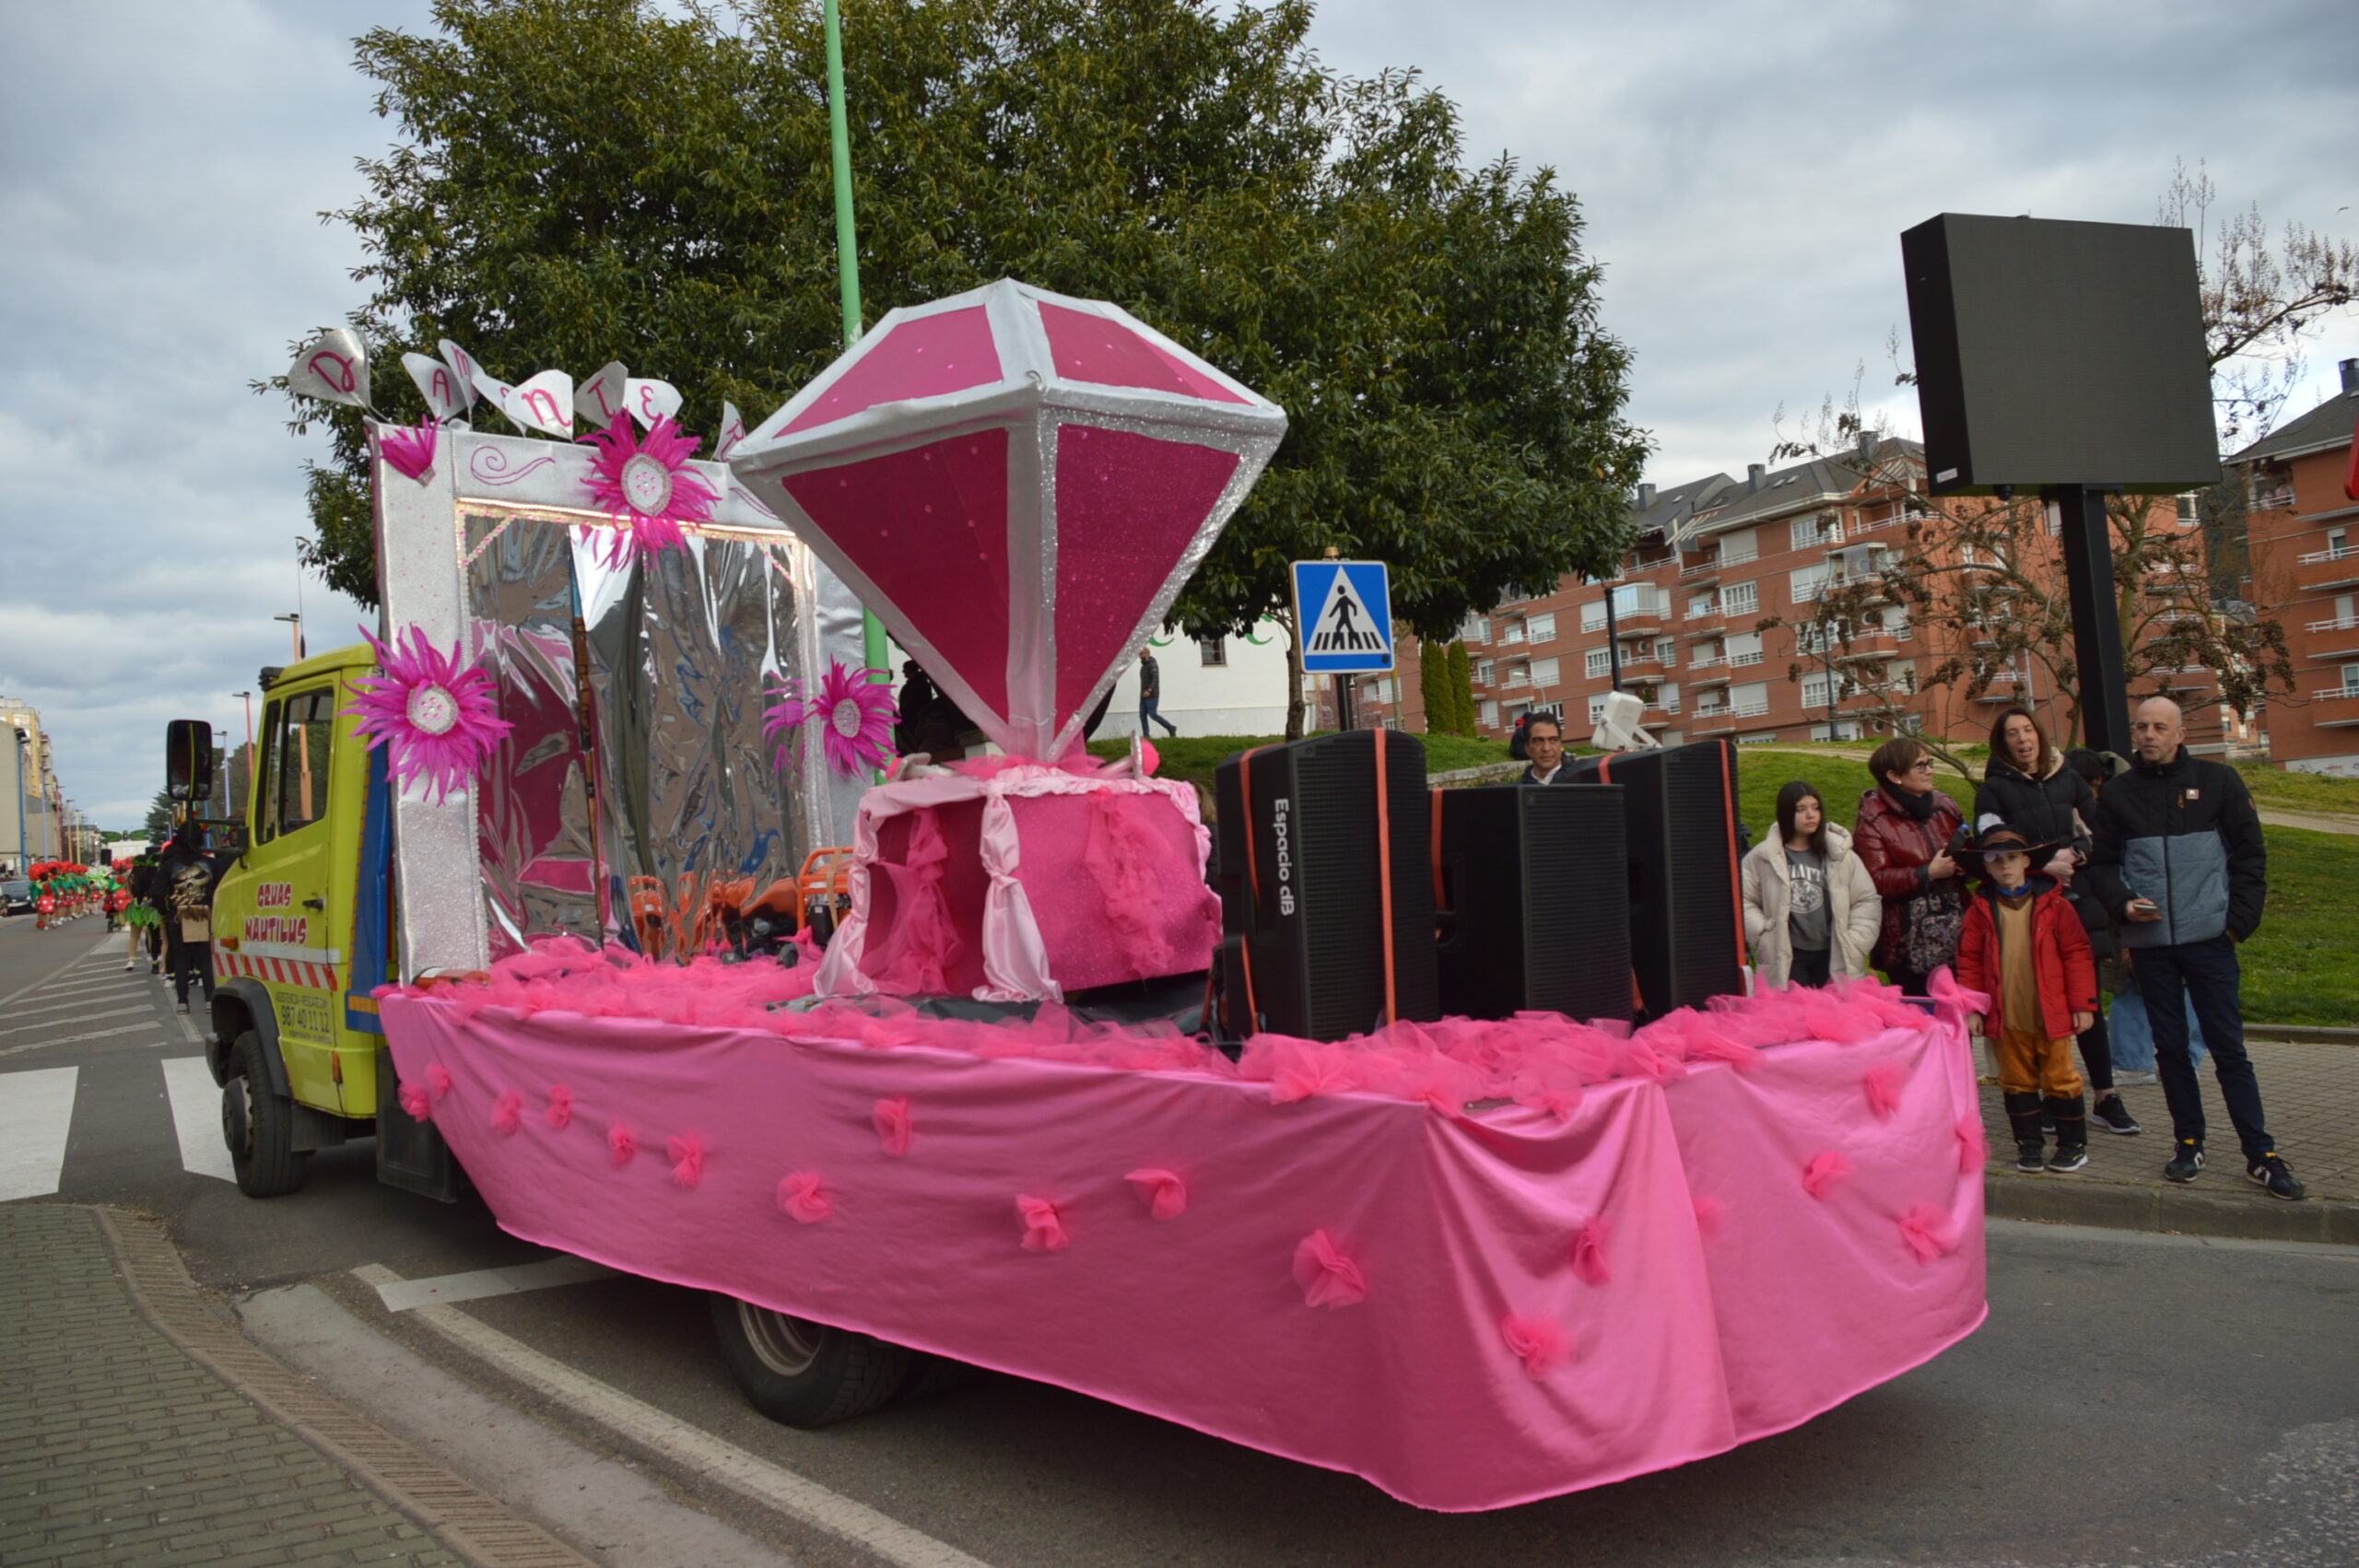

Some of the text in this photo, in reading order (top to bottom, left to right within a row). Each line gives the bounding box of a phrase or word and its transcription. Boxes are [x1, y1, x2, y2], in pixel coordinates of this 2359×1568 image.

[1273, 798, 1295, 916] Espacio dB
[257, 883, 292, 908] GRUAS
[244, 916, 308, 944] NAUTILUS
